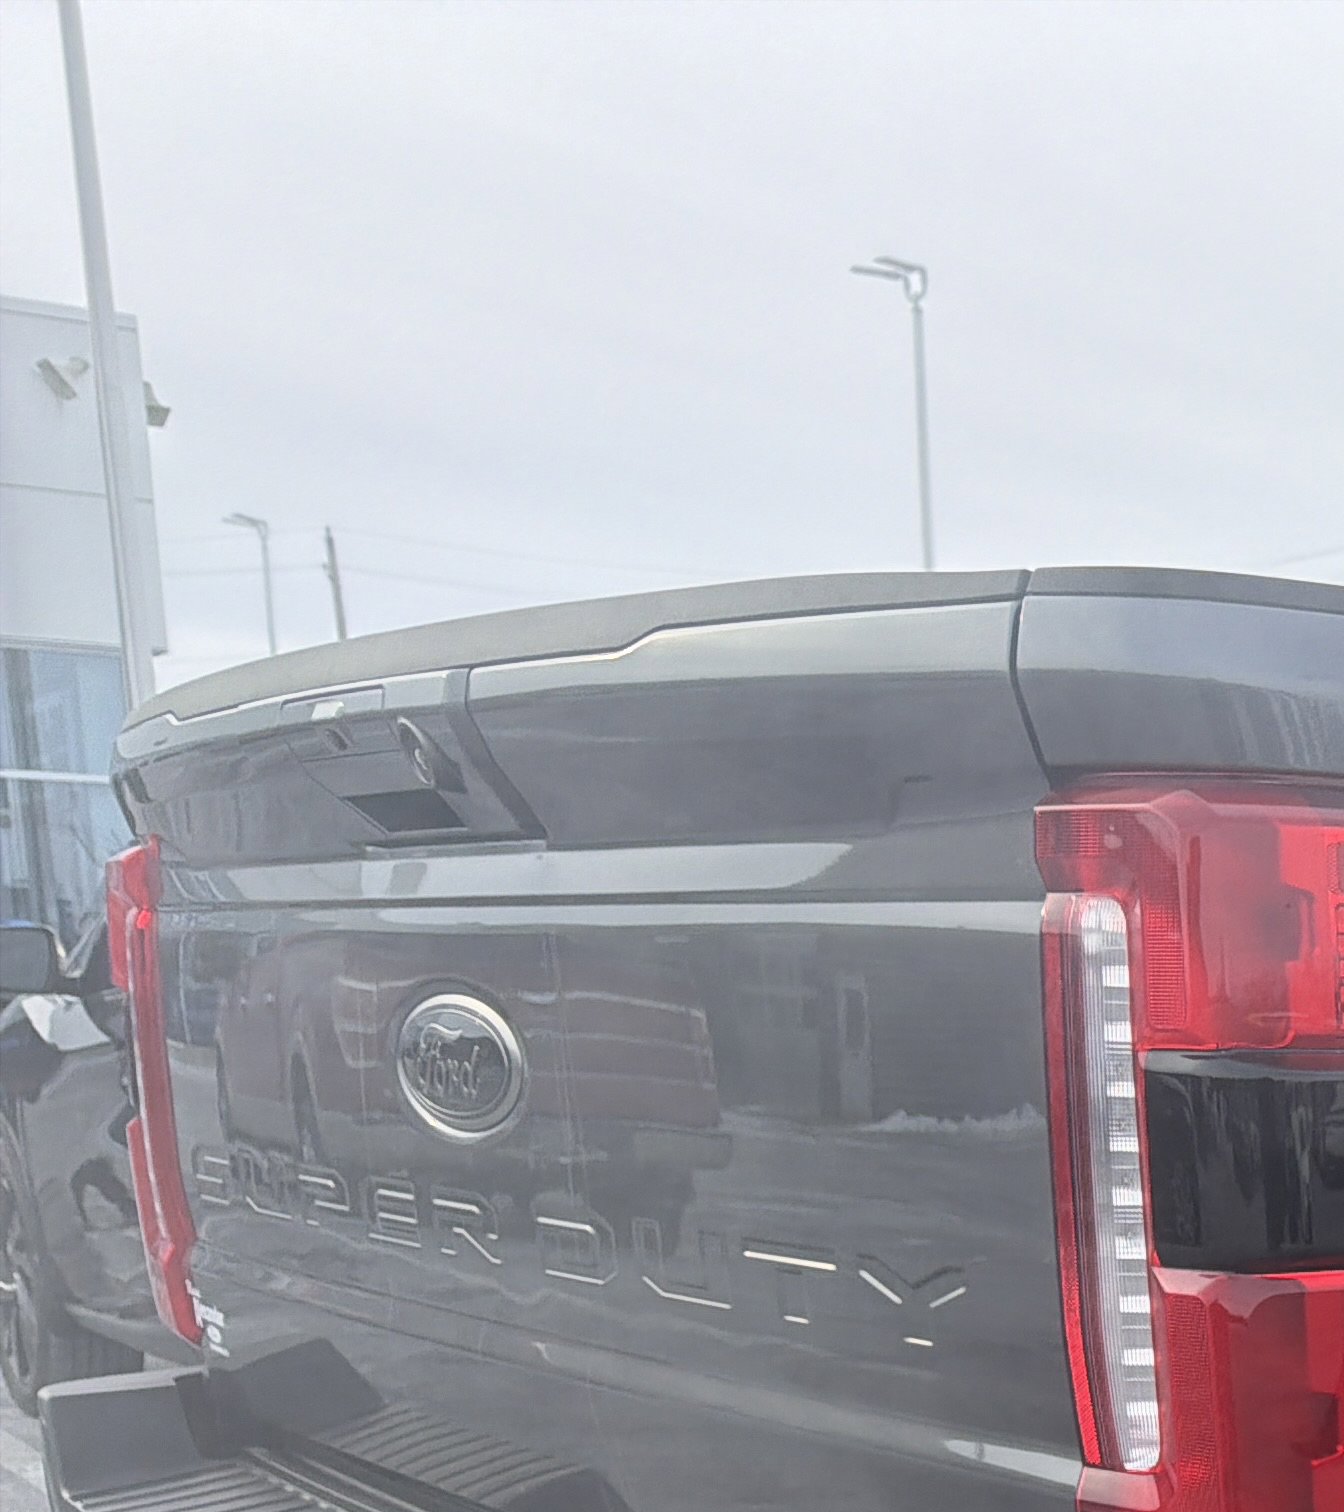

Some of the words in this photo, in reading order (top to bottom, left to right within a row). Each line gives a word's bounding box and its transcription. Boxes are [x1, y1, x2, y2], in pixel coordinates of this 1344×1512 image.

[416, 1021, 481, 1099] Ford
[192, 1145, 502, 1264] SUPER
[534, 1212, 967, 1347] DUTY
